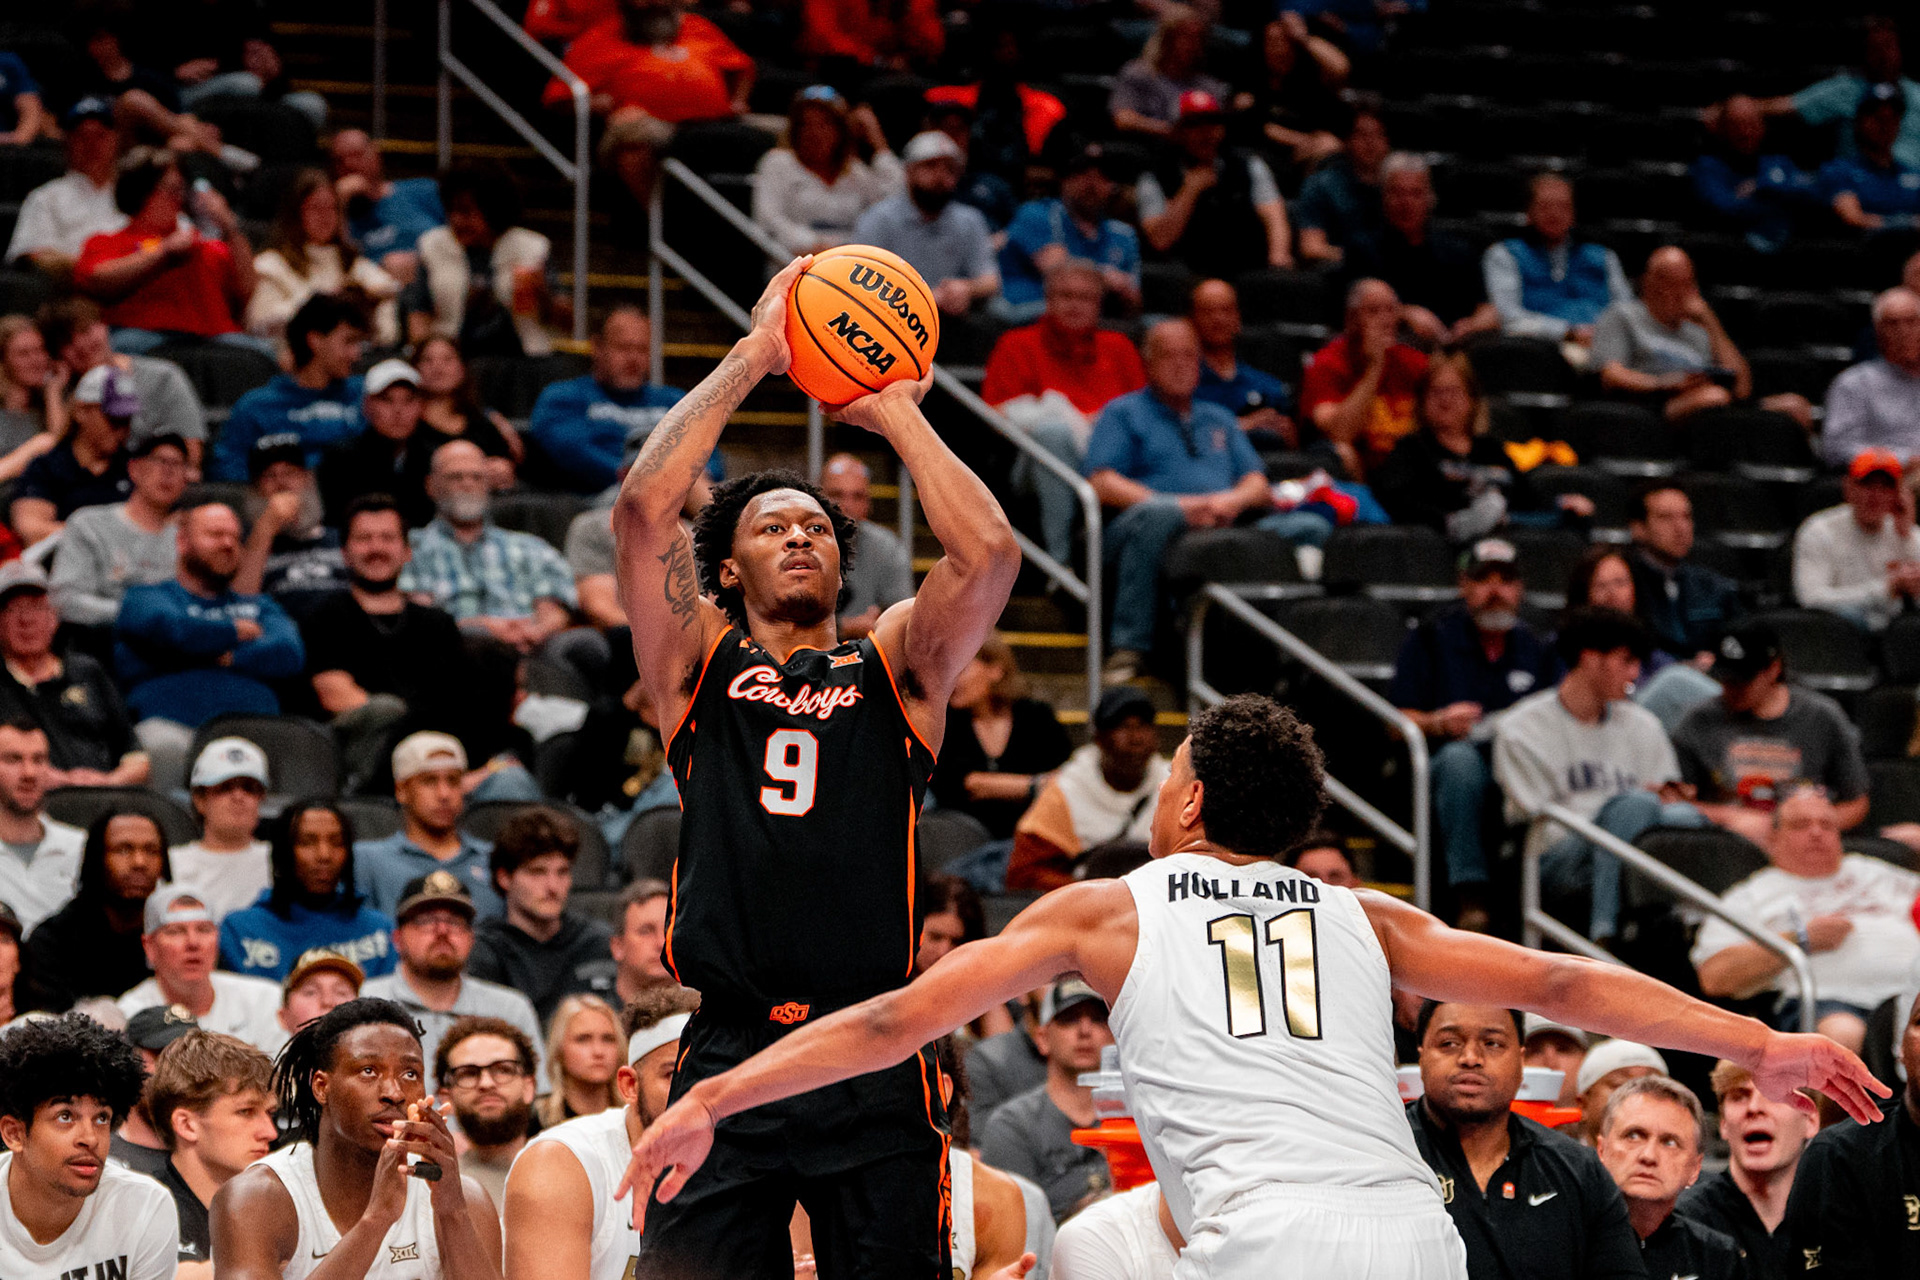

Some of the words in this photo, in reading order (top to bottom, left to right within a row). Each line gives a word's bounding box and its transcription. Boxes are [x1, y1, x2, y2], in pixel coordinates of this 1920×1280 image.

[848, 263, 929, 351] Wilson
[827, 311, 897, 375] NCAA
[727, 664, 864, 720] Cowboys
[759, 728, 819, 817] 9
[1168, 872, 1321, 904] HOLLAND
[1206, 908, 1323, 1041] 11
[770, 1002, 810, 1024] OSU
[389, 1242, 419, 1264] XII
